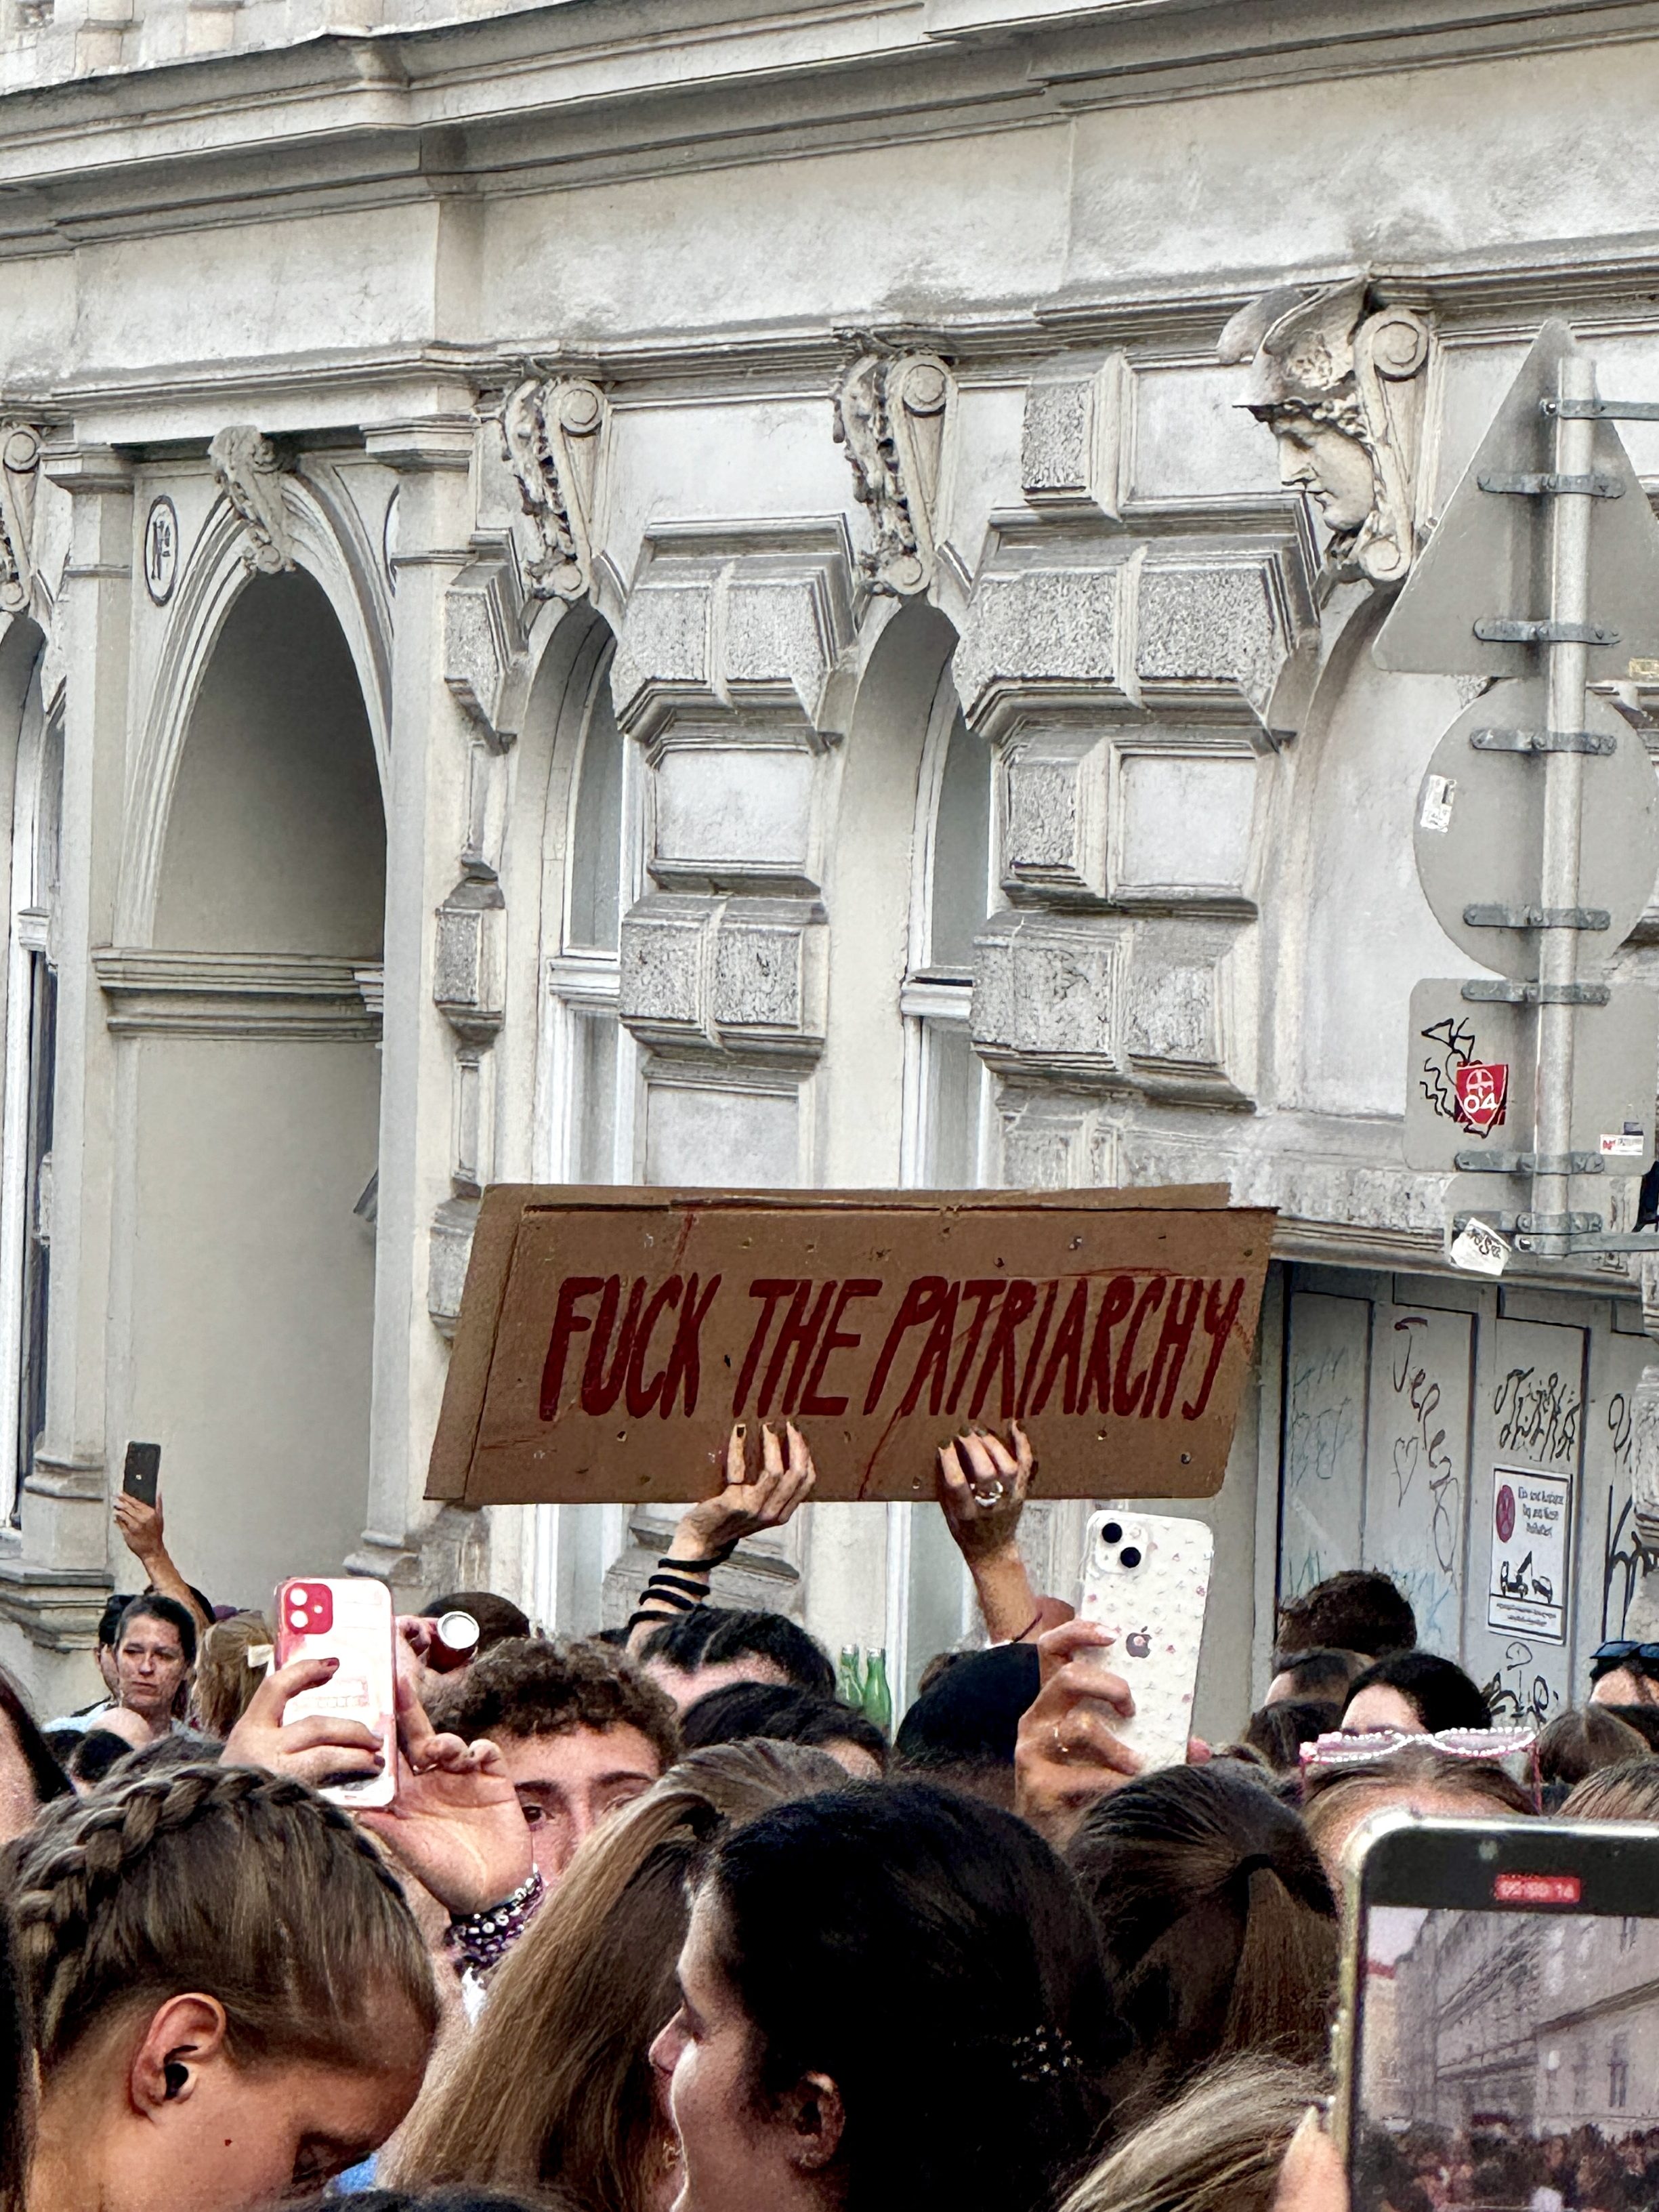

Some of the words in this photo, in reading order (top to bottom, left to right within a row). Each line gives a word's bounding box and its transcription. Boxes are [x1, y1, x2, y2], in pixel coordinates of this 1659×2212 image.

[1463, 1092, 1499, 1114] 04
[540, 1272, 722, 1421] FUCK
[733, 1278, 883, 1419] THE
[863, 1275, 1245, 1421] PATRIARCHY
